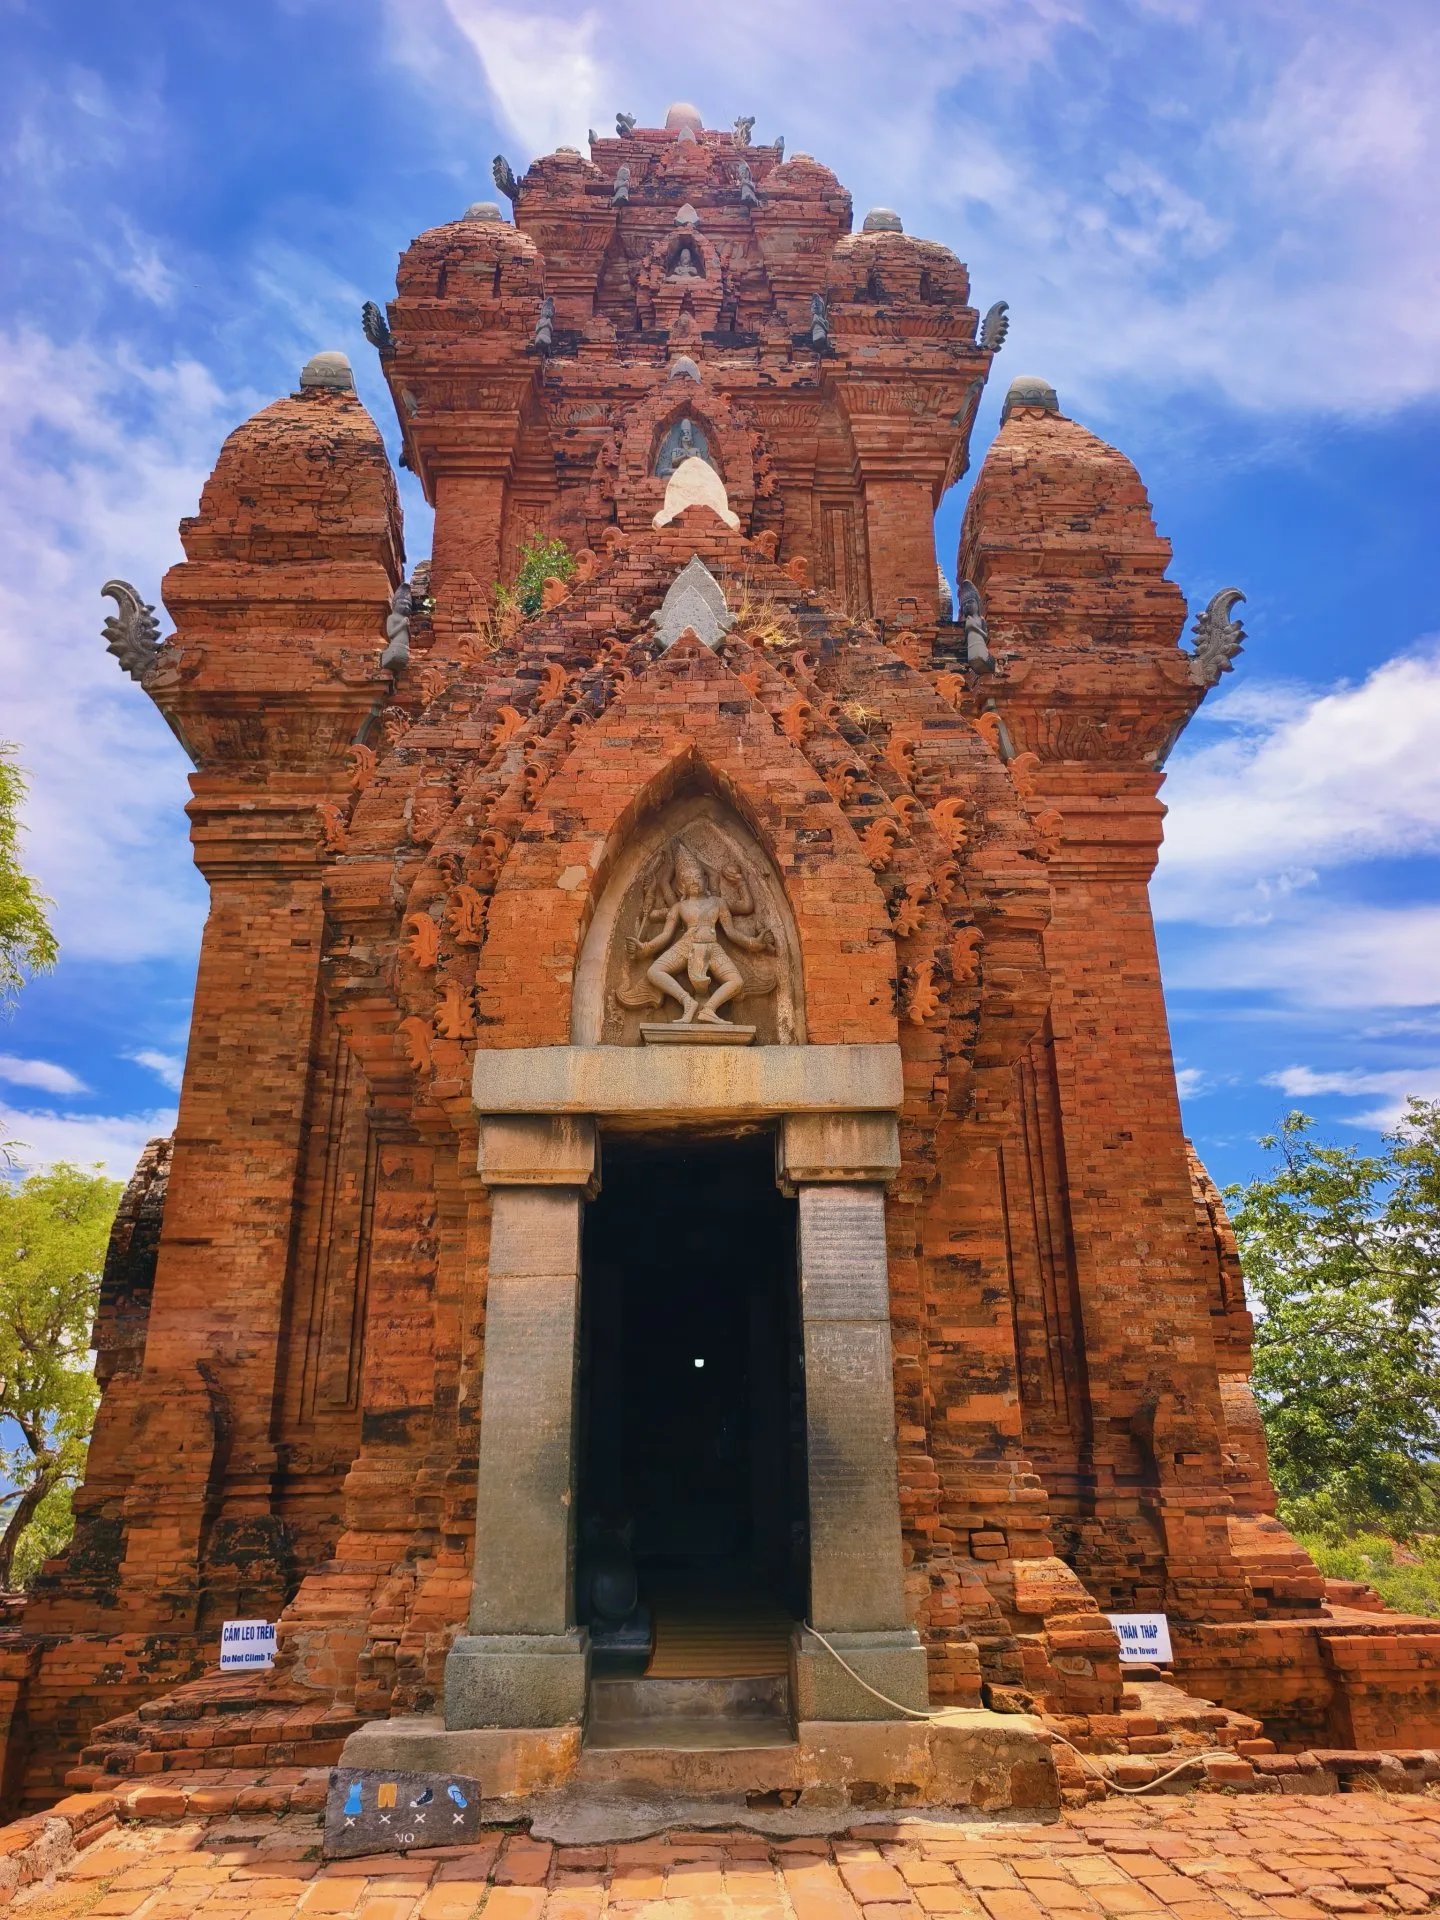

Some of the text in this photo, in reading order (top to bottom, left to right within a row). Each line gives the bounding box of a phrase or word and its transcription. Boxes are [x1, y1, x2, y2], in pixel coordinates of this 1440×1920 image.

[242, 1626, 254, 1640] LEO
[1126, 1647, 1137, 1655] The
[1138, 1647, 1158, 1655] Tower
[222, 1655, 231, 1663] Do
[231, 1654, 243, 1662] Not
[245, 1653, 265, 1662] Climb
[395, 1832, 414, 1843] NO
